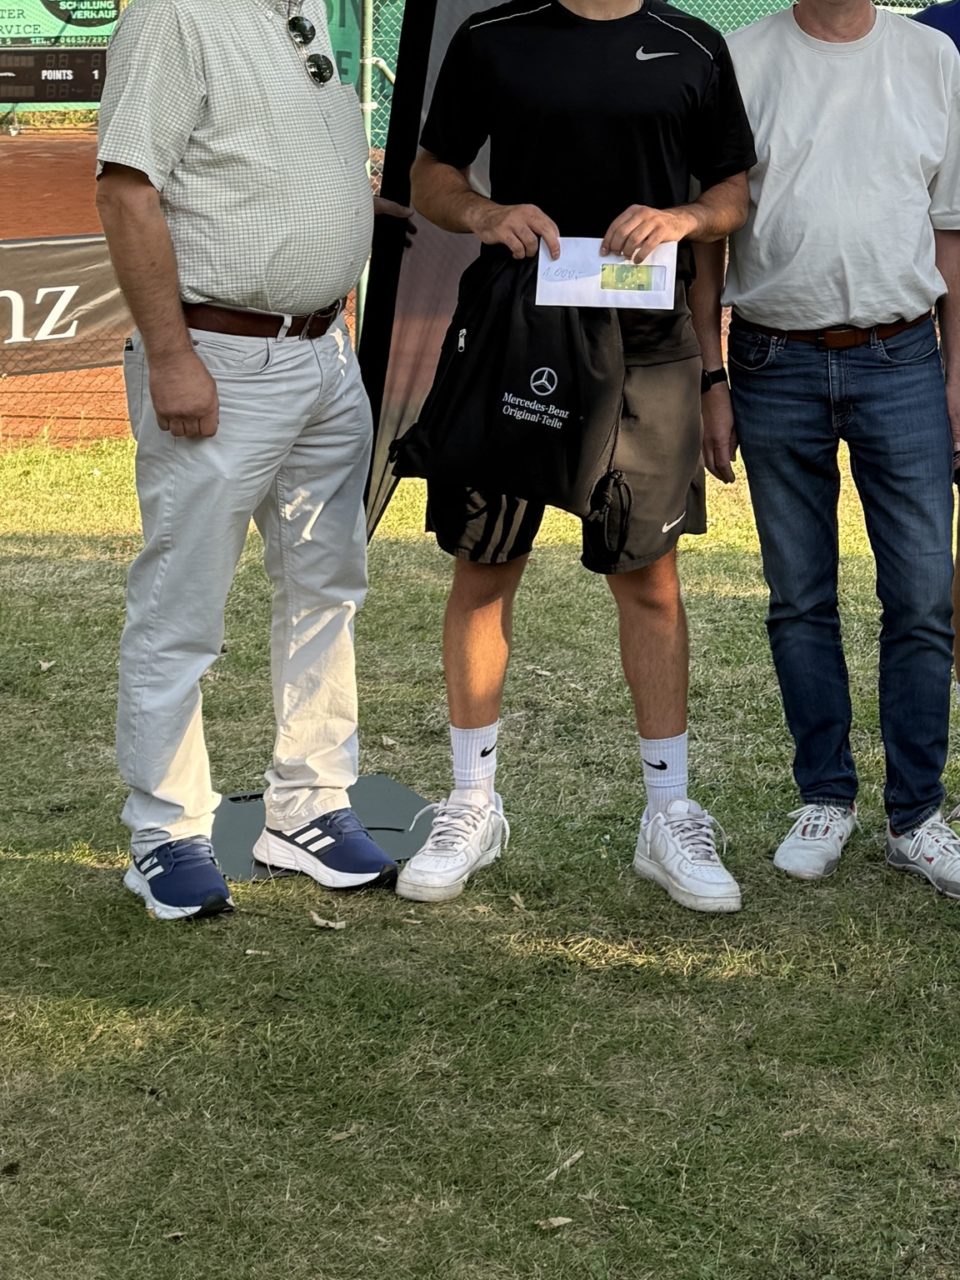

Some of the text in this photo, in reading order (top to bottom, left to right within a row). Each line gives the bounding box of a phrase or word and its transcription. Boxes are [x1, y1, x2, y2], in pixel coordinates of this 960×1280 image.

[59, 1, 115, 10] SCHULUNG
[70, 10, 118, 19] VERKAUF
[41, 69, 100, 80] POINTS 1
[502, 391, 570, 419] Mercedes-Benz
[502, 404, 563, 430] Original-Teile
